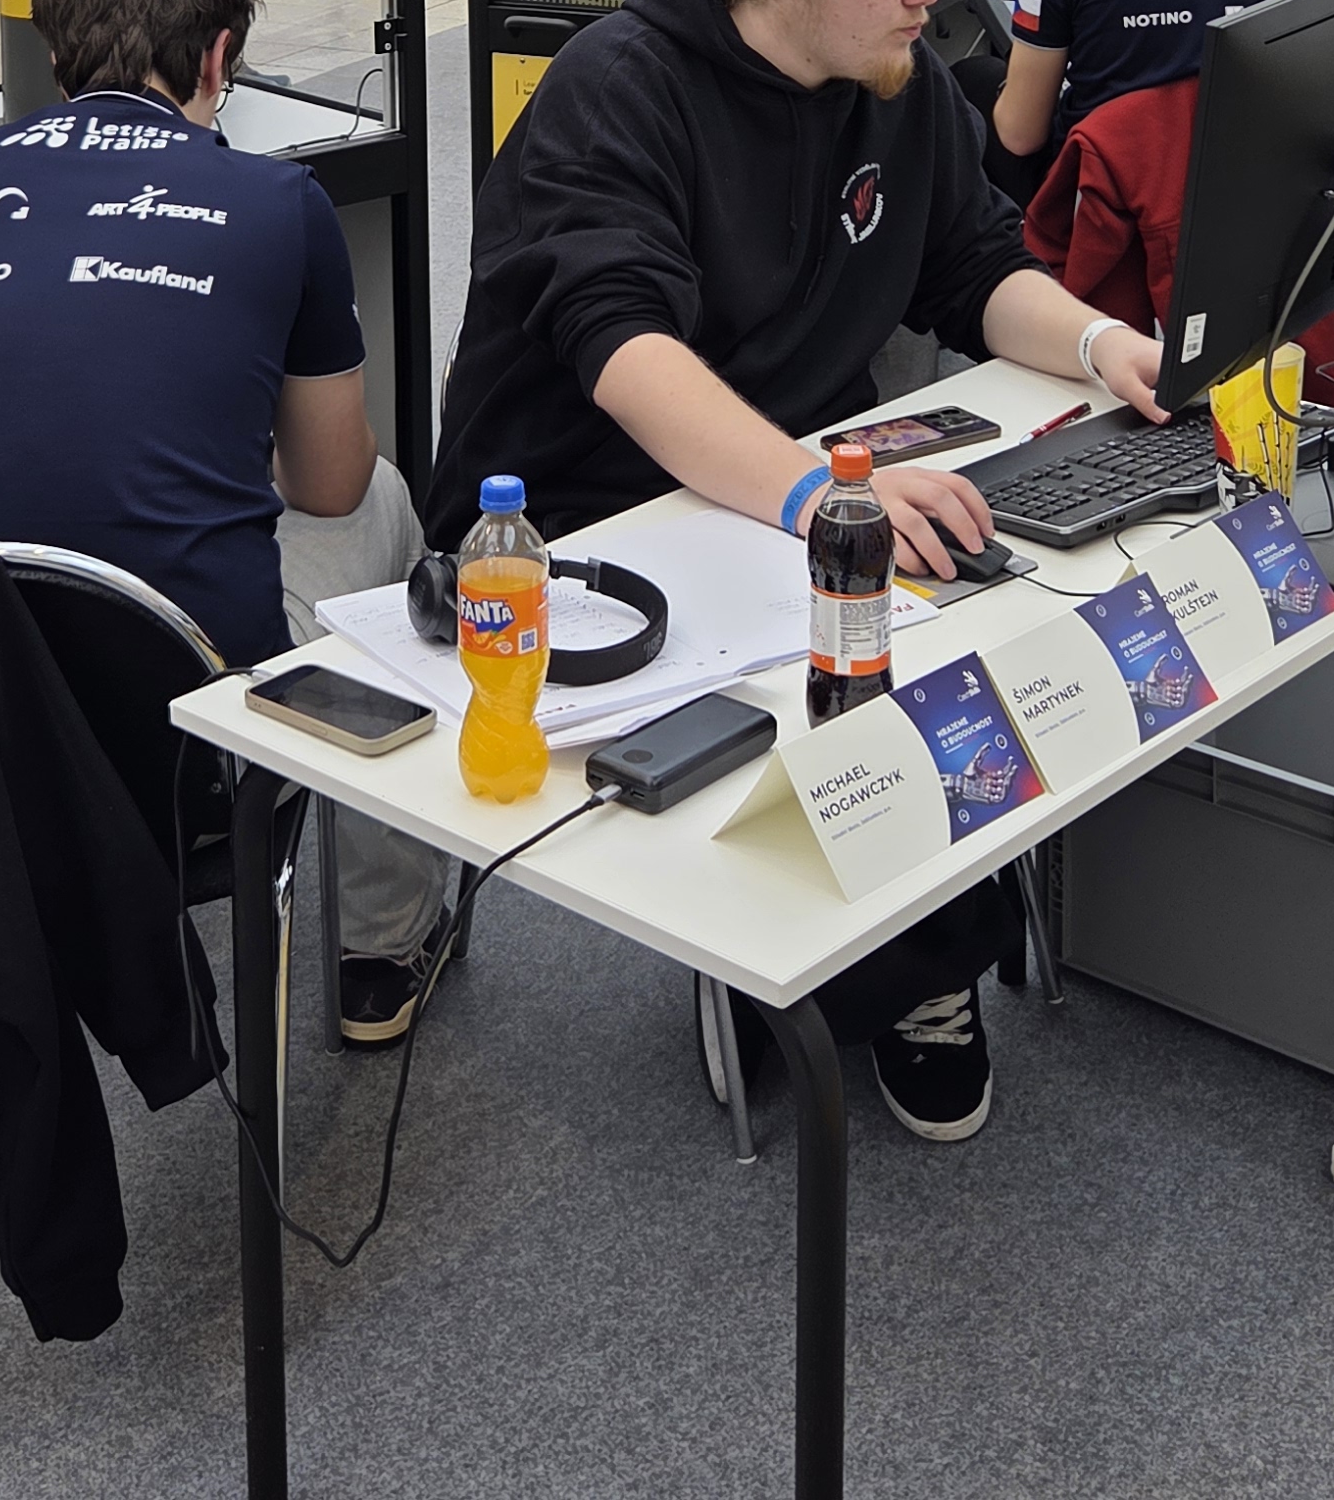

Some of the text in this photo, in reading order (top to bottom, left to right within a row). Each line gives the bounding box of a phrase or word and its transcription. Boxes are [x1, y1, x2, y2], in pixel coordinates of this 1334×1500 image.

[1123, 10, 1193, 29] NOTINO
[80, 133, 168, 151] Praha
[100, 261, 214, 295] Kaufland
[1161, 579, 1200, 604] ROMAN
[460, 593, 514, 624] FANTA
[1012, 675, 1052, 705] ŠIMON
[1022, 680, 1085, 723] MARTYNEK
[809, 763, 871, 803] MICHAEL
[819, 768, 906, 824] NOGAWCZYK
